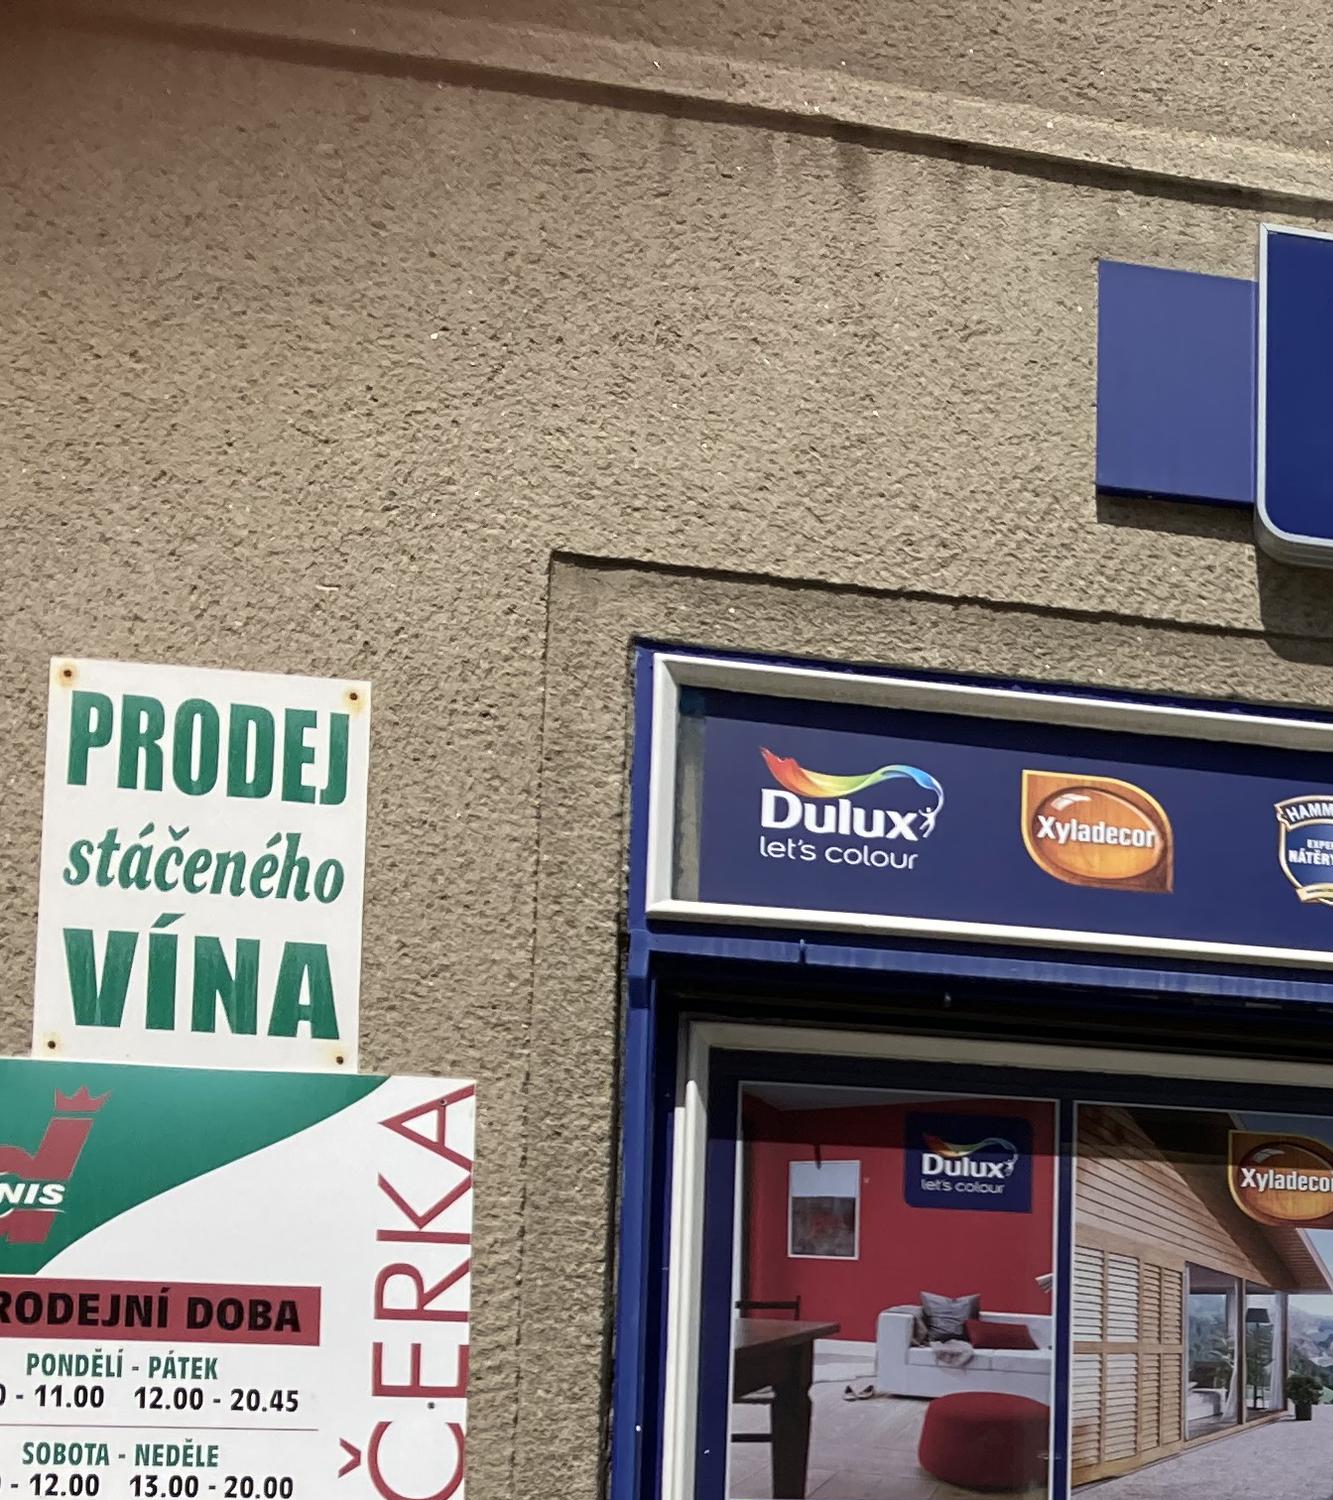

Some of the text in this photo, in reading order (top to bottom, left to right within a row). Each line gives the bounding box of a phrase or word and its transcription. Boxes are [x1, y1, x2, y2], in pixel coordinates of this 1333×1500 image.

[67, 690, 350, 805] PRODEJ
[760, 788, 919, 842] Dulux
[1036, 814, 1157, 849] Xyladecor
[62, 822, 345, 904] stáčeného
[760, 836, 918, 870] let's colour
[62, 912, 340, 1040] VÍNA
[921, 1152, 1005, 1179] Dulux
[920, 1178, 1005, 1195] let's colour
[186, 1296, 302, 1333] DOBA
[26, 1348, 218, 1381] PONDĚLÍ PÁTEK
[34, 1384, 104, 1408] 11.00
[134, 1386, 204, 1411] 12.00
[230, 1389, 299, 1413] 20.45
[22, 1438, 219, 1468] SOBOTA NEDĚLE
[29, 1473, 294, 1500] 12.00 13.00 20.00
